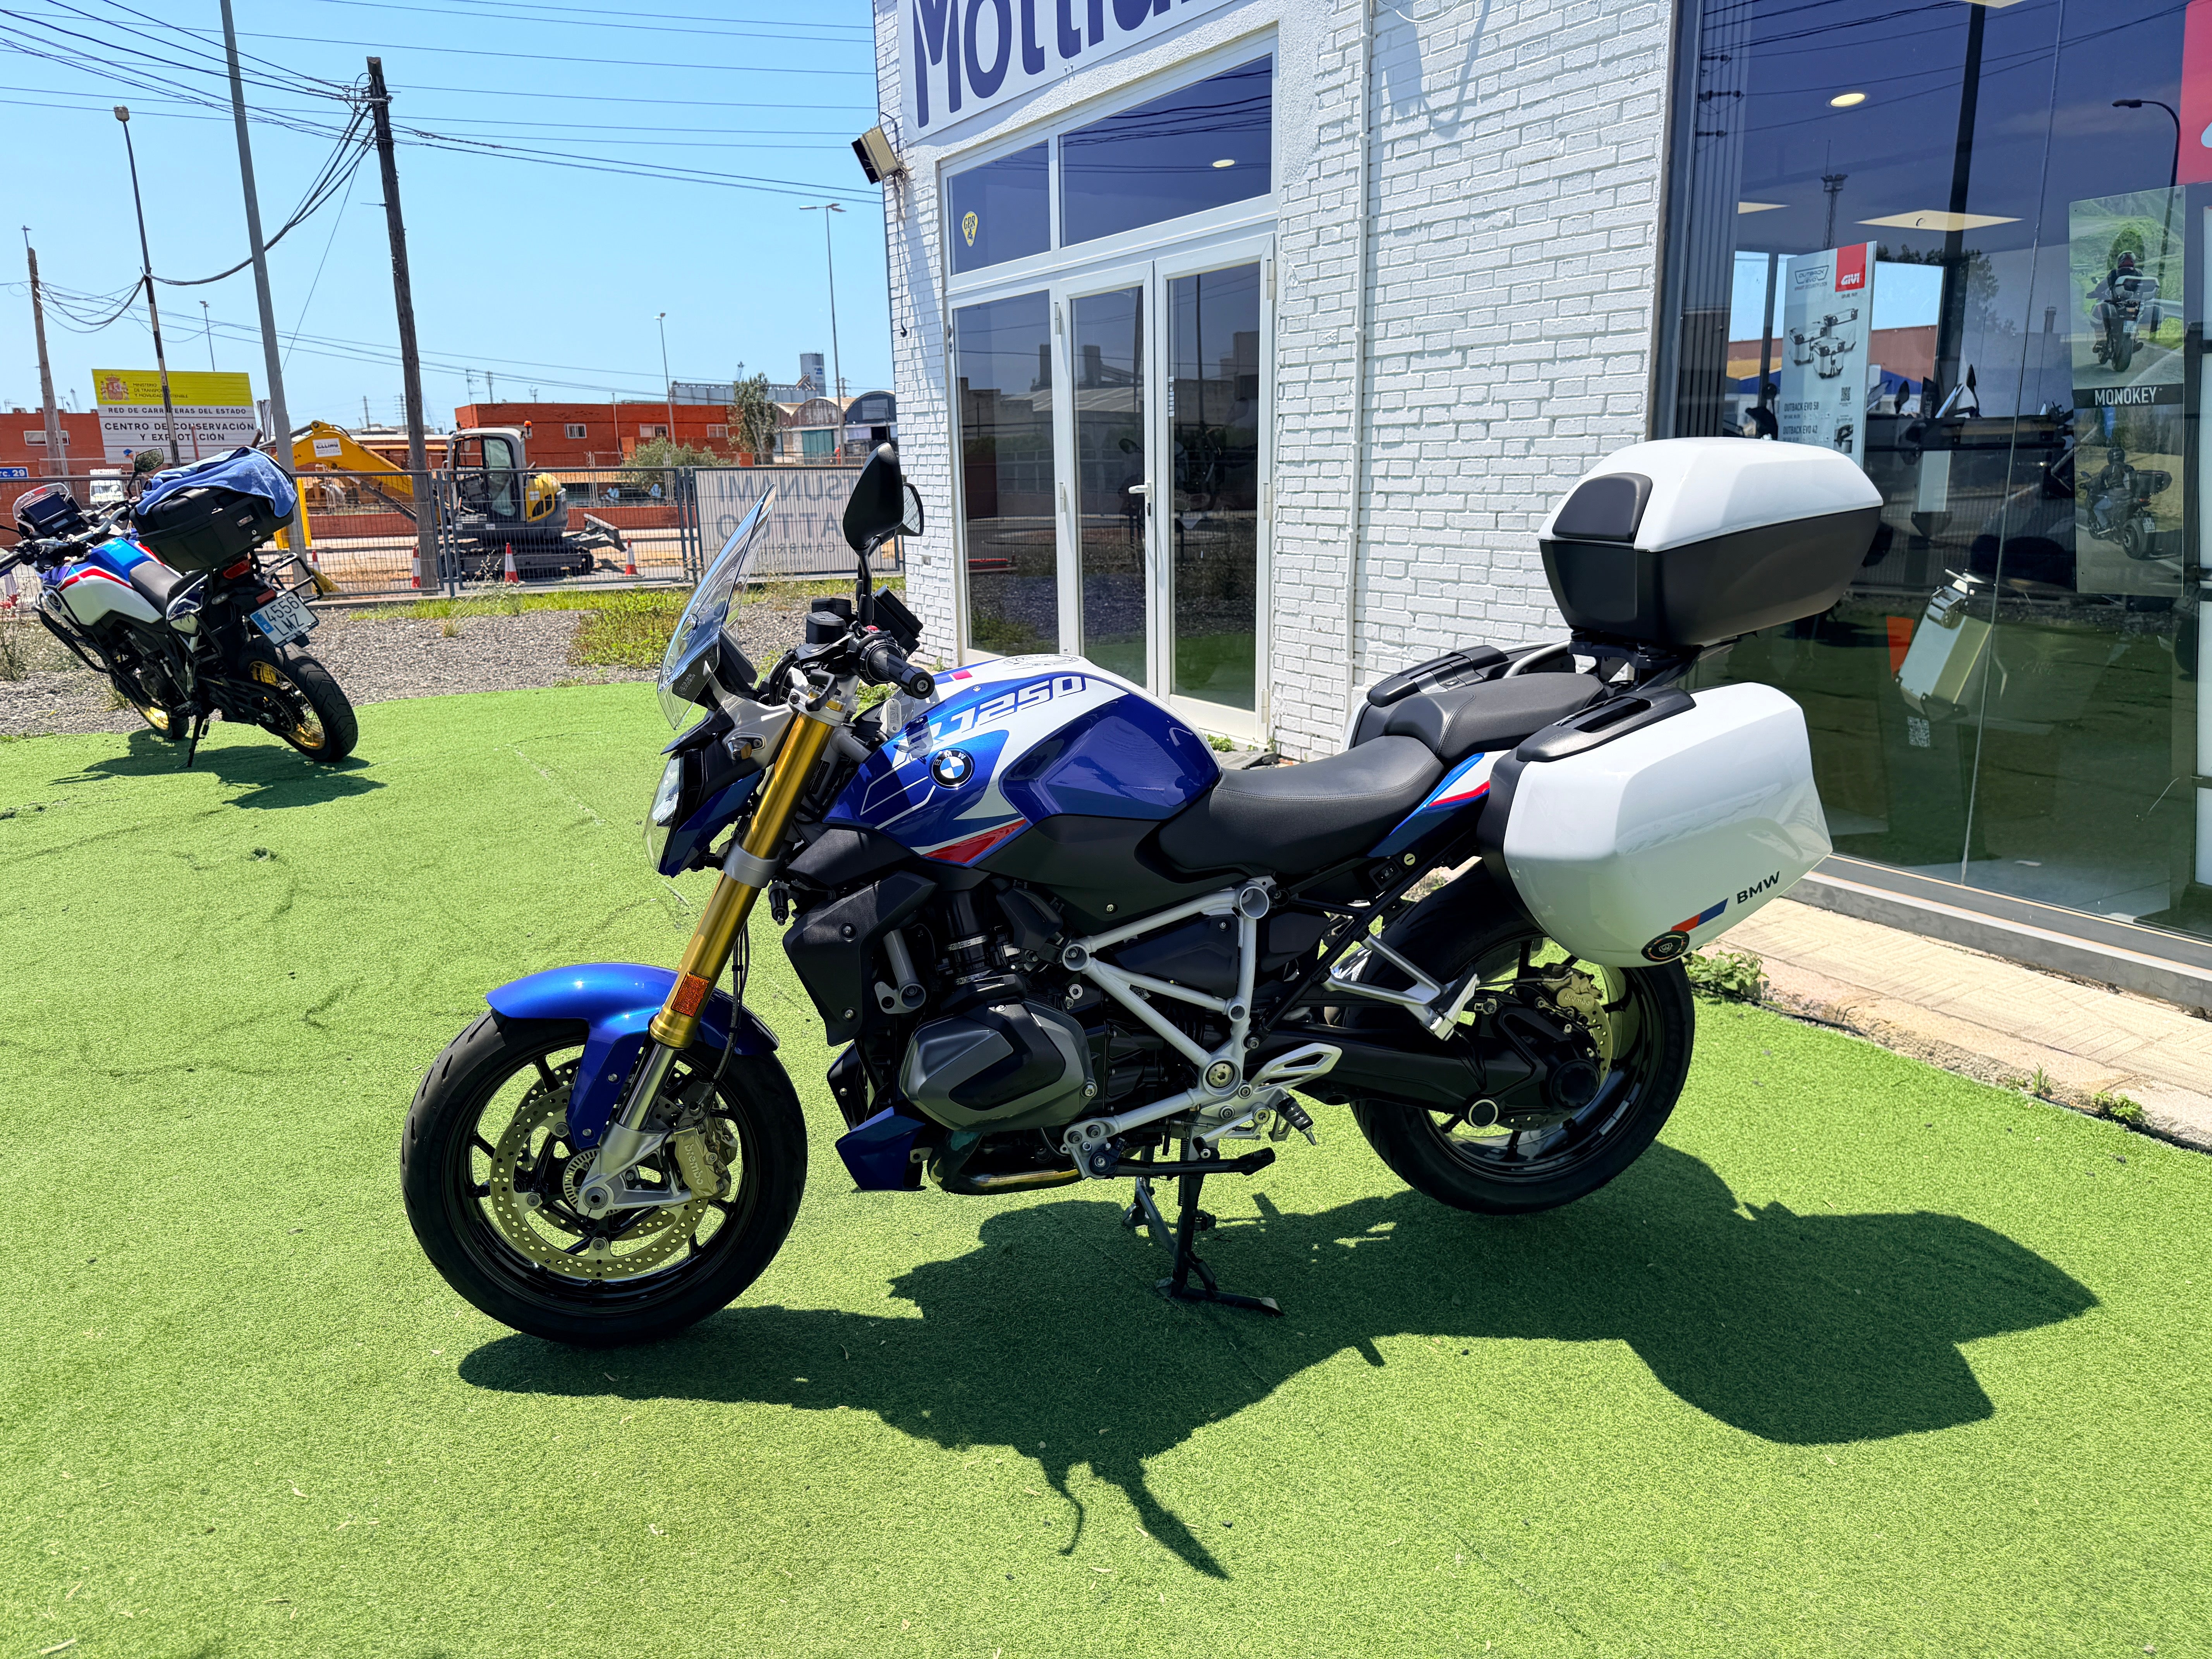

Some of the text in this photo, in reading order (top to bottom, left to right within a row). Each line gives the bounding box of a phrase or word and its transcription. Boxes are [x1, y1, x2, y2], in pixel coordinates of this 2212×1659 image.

[964, 215, 975, 230] GPR
[1841, 272, 1860, 285] GIVI
[2095, 386, 2157, 406] MONOKEY
[1804, 402, 1813, 411] EVO
[151, 433, 225, 441] EXPOTCIÓN
[1803, 425, 1812, 434] EVO
[264, 596, 300, 622] 4556
[273, 613, 304, 636] LMZ
[934, 749, 967, 766] BMW
[1736, 871, 1780, 904] BMW
[1564, 993, 1590, 1006] brembo
[684, 1142, 704, 1185] brembo
